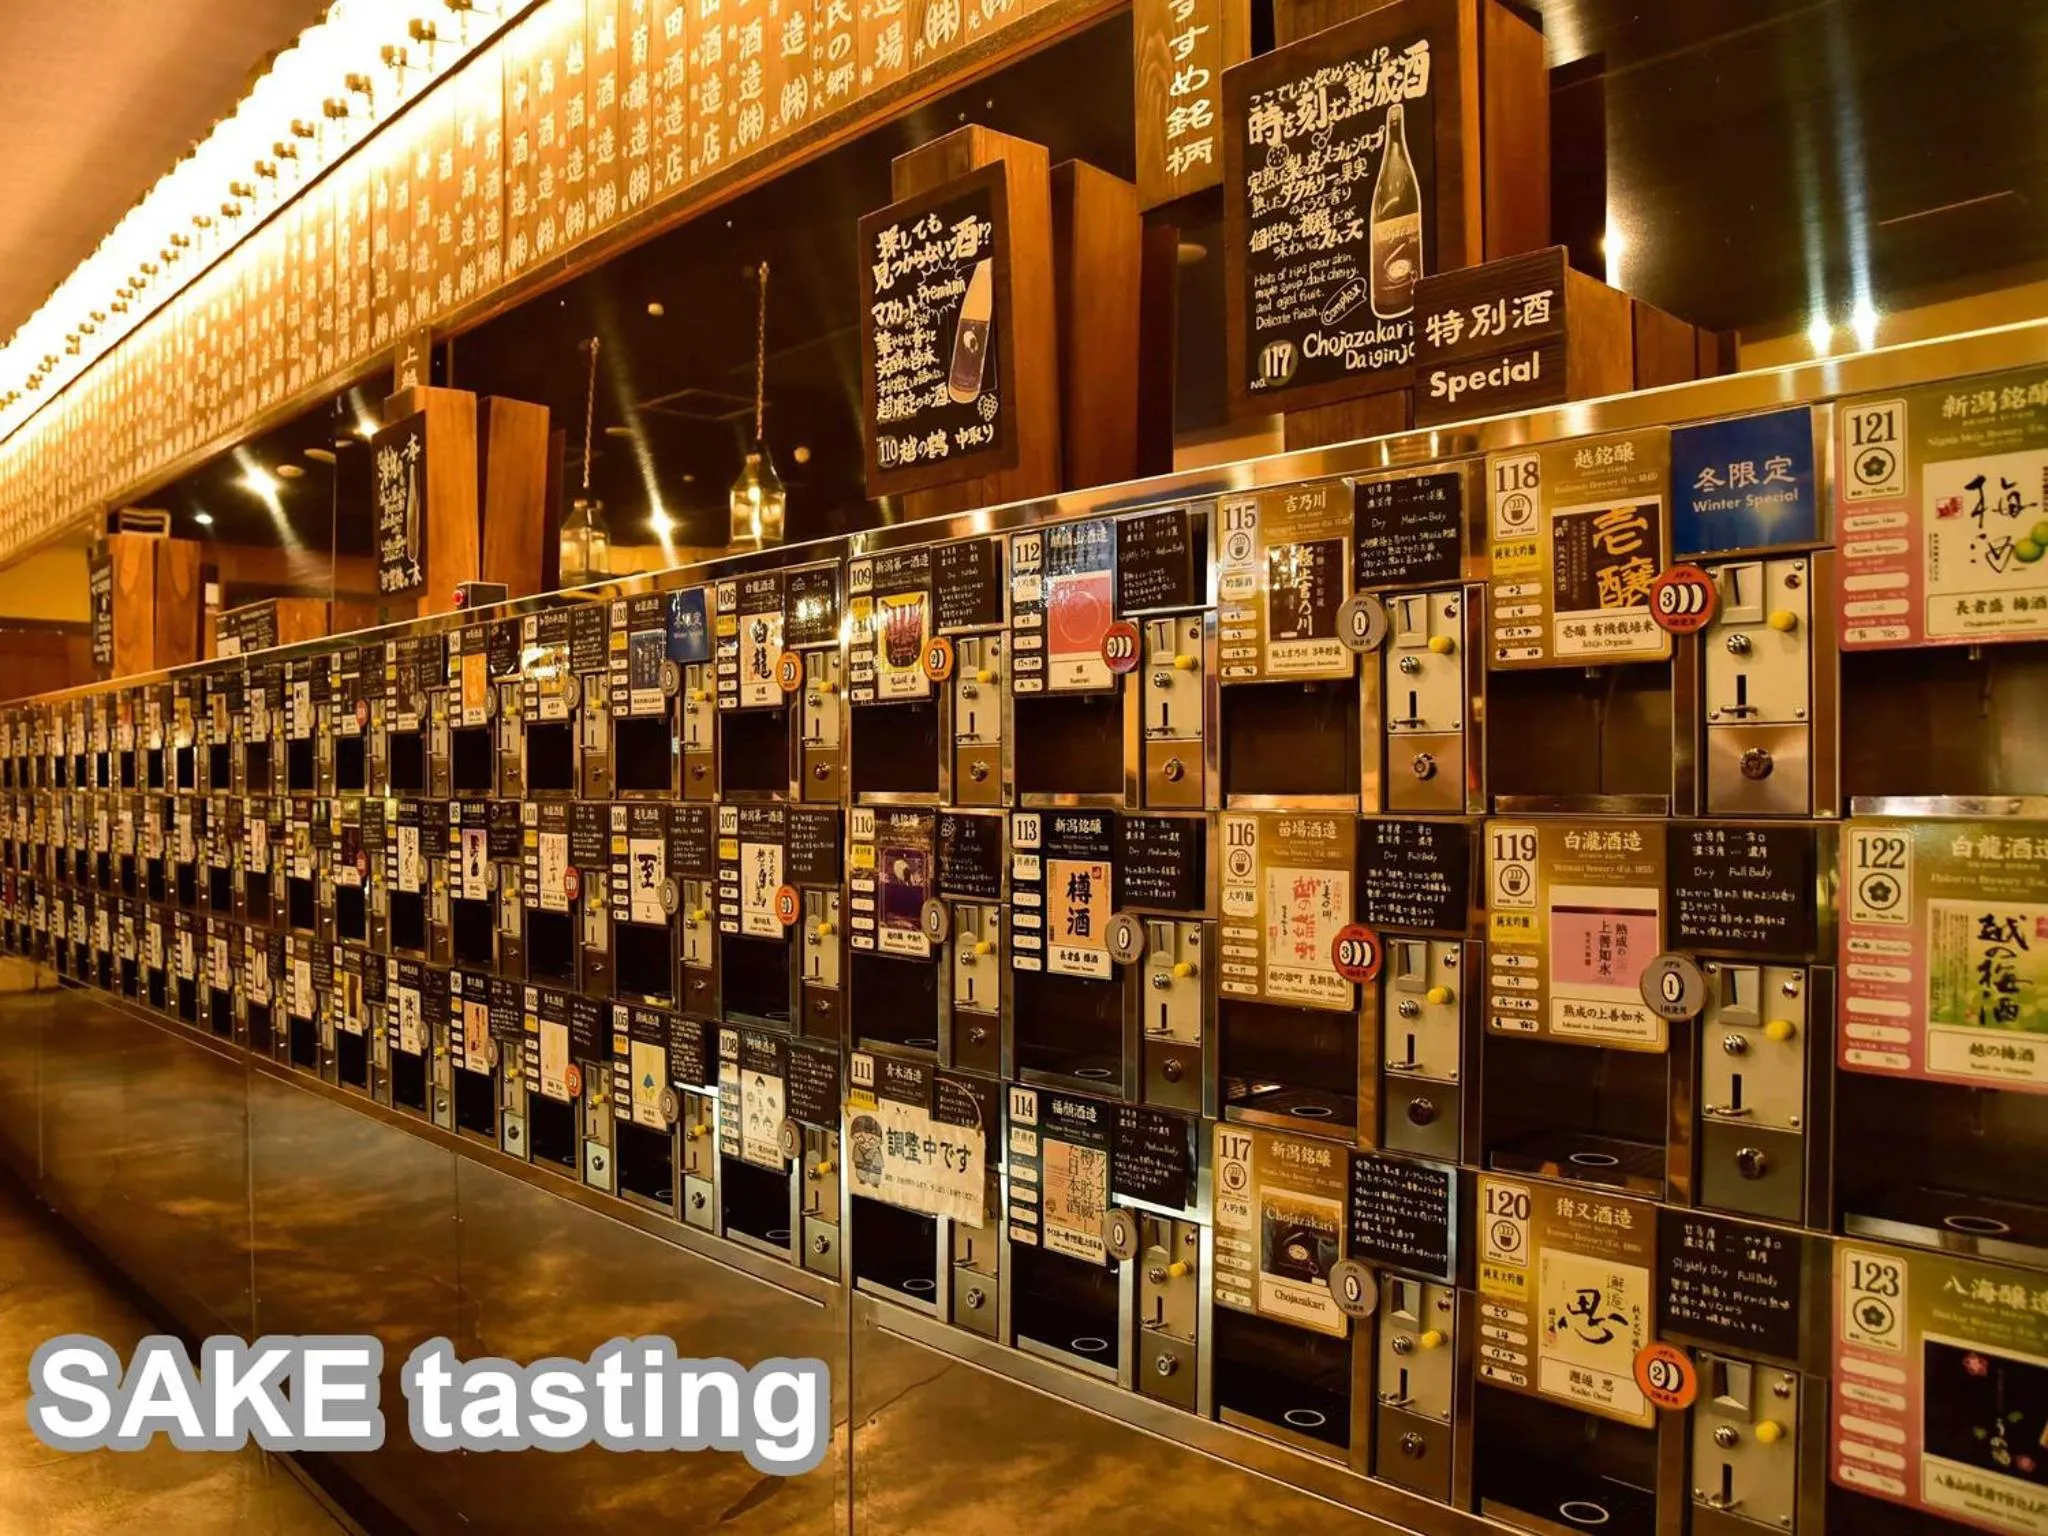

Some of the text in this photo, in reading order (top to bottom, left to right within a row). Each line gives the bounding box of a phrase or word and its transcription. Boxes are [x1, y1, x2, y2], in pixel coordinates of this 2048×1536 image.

[1425, 290, 1554, 348] 特別酒
[1303, 320, 1414, 358] Chojazakari
[1430, 351, 1540, 402] Special
[1852, 410, 1897, 446] 121
[1496, 462, 1539, 493] 118
[1693, 455, 1796, 492] 冬限定
[1284, 491, 1326, 513] 吉乃川
[1693, 488, 1798, 513] Winter Special
[1223, 504, 1256, 531] 115
[1015, 542, 1040, 564] 112
[852, 567, 872, 587] 109
[1662, 591, 1673, 607] 3
[721, 813, 737, 830] 107
[854, 816, 873, 834] 110
[1017, 819, 1037, 841] 113
[1228, 822, 1255, 846] 116
[1278, 820, 1338, 839] 苗場酒造
[1492, 833, 1538, 861] 119
[1858, 837, 1905, 869] 122
[1066, 872, 1093, 938] 樽酒
[1342, 945, 1350, 960] 3
[721, 1036, 737, 1054] 108
[1969, 1042, 2035, 1062] 越の梅酒
[854, 1060, 871, 1080] 111
[1014, 1094, 1034, 1118] 114
[886, 1126, 972, 1173] 調整中です
[1219, 1135, 1252, 1162] 117
[1486, 1188, 1531, 1220] 120
[1265, 1206, 1334, 1233] Chojazakari
[1851, 1259, 1899, 1298] 123
[1274, 1288, 1327, 1313] Chojazakari
[1653, 1363, 1663, 1381] 2
